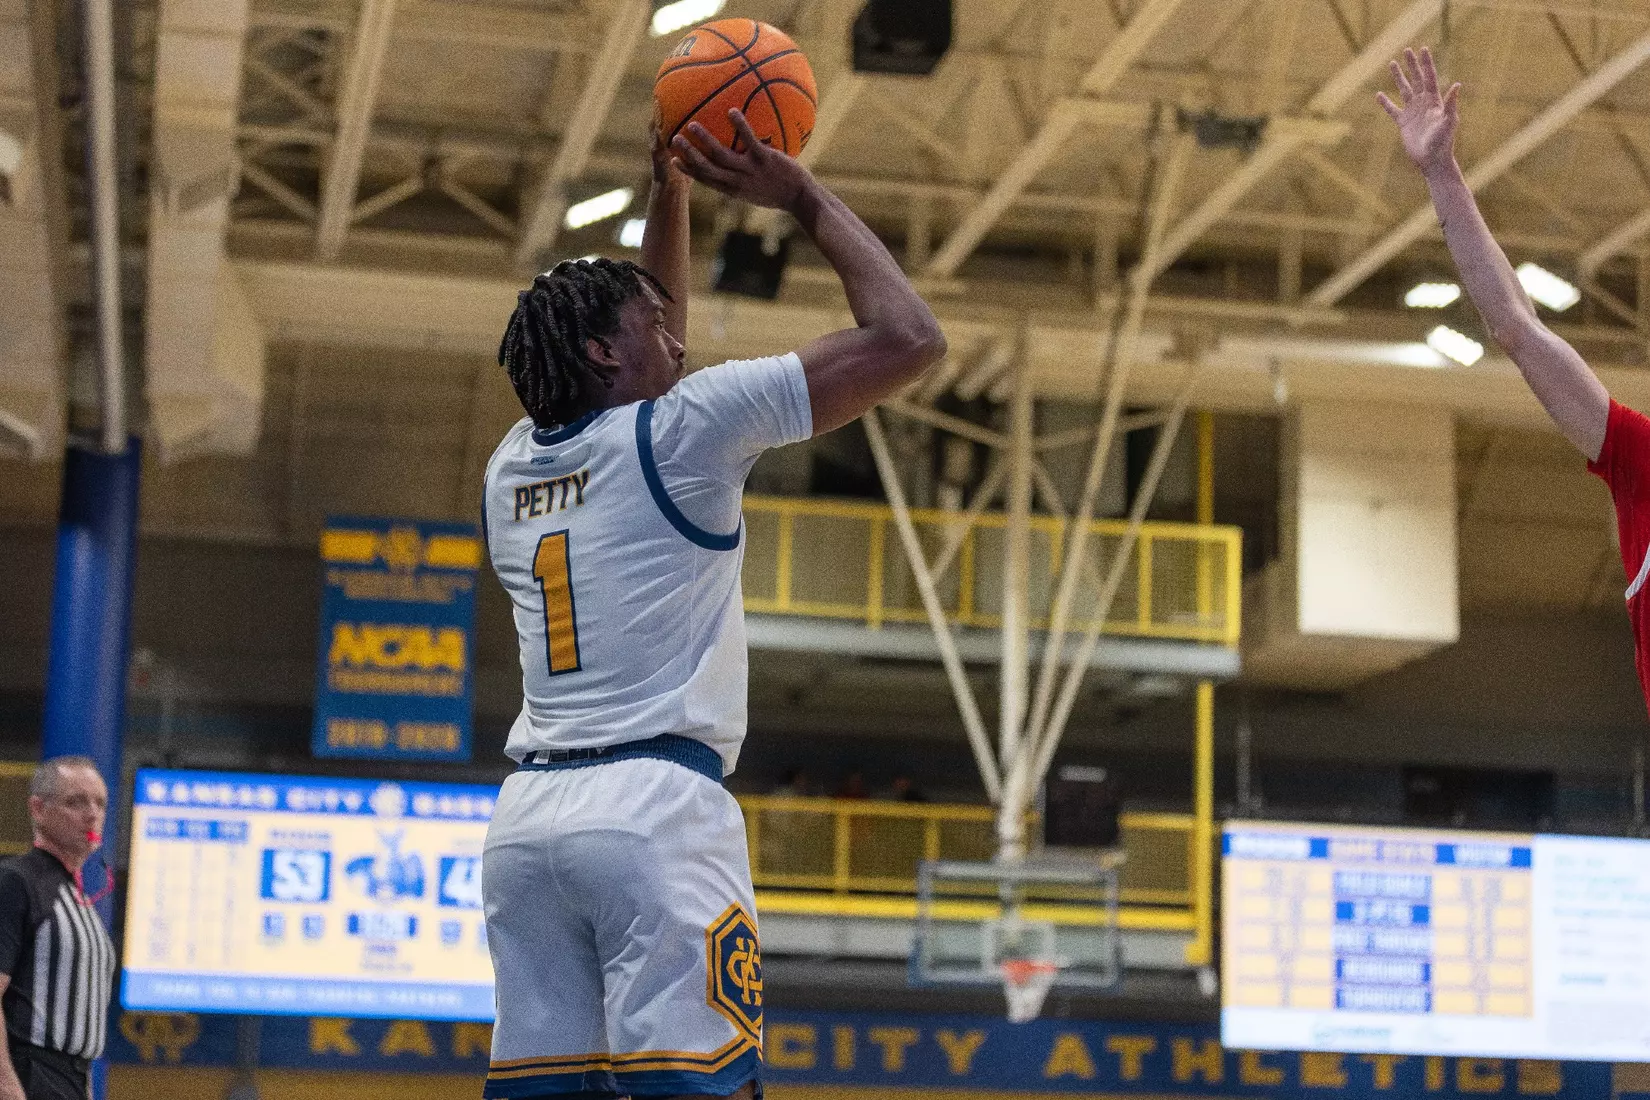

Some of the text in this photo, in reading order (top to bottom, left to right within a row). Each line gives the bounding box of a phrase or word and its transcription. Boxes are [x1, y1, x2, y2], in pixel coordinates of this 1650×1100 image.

[515, 469, 590, 522] PETTY
[532, 528, 583, 676] 1
[765, 1023, 987, 1074] CITY
